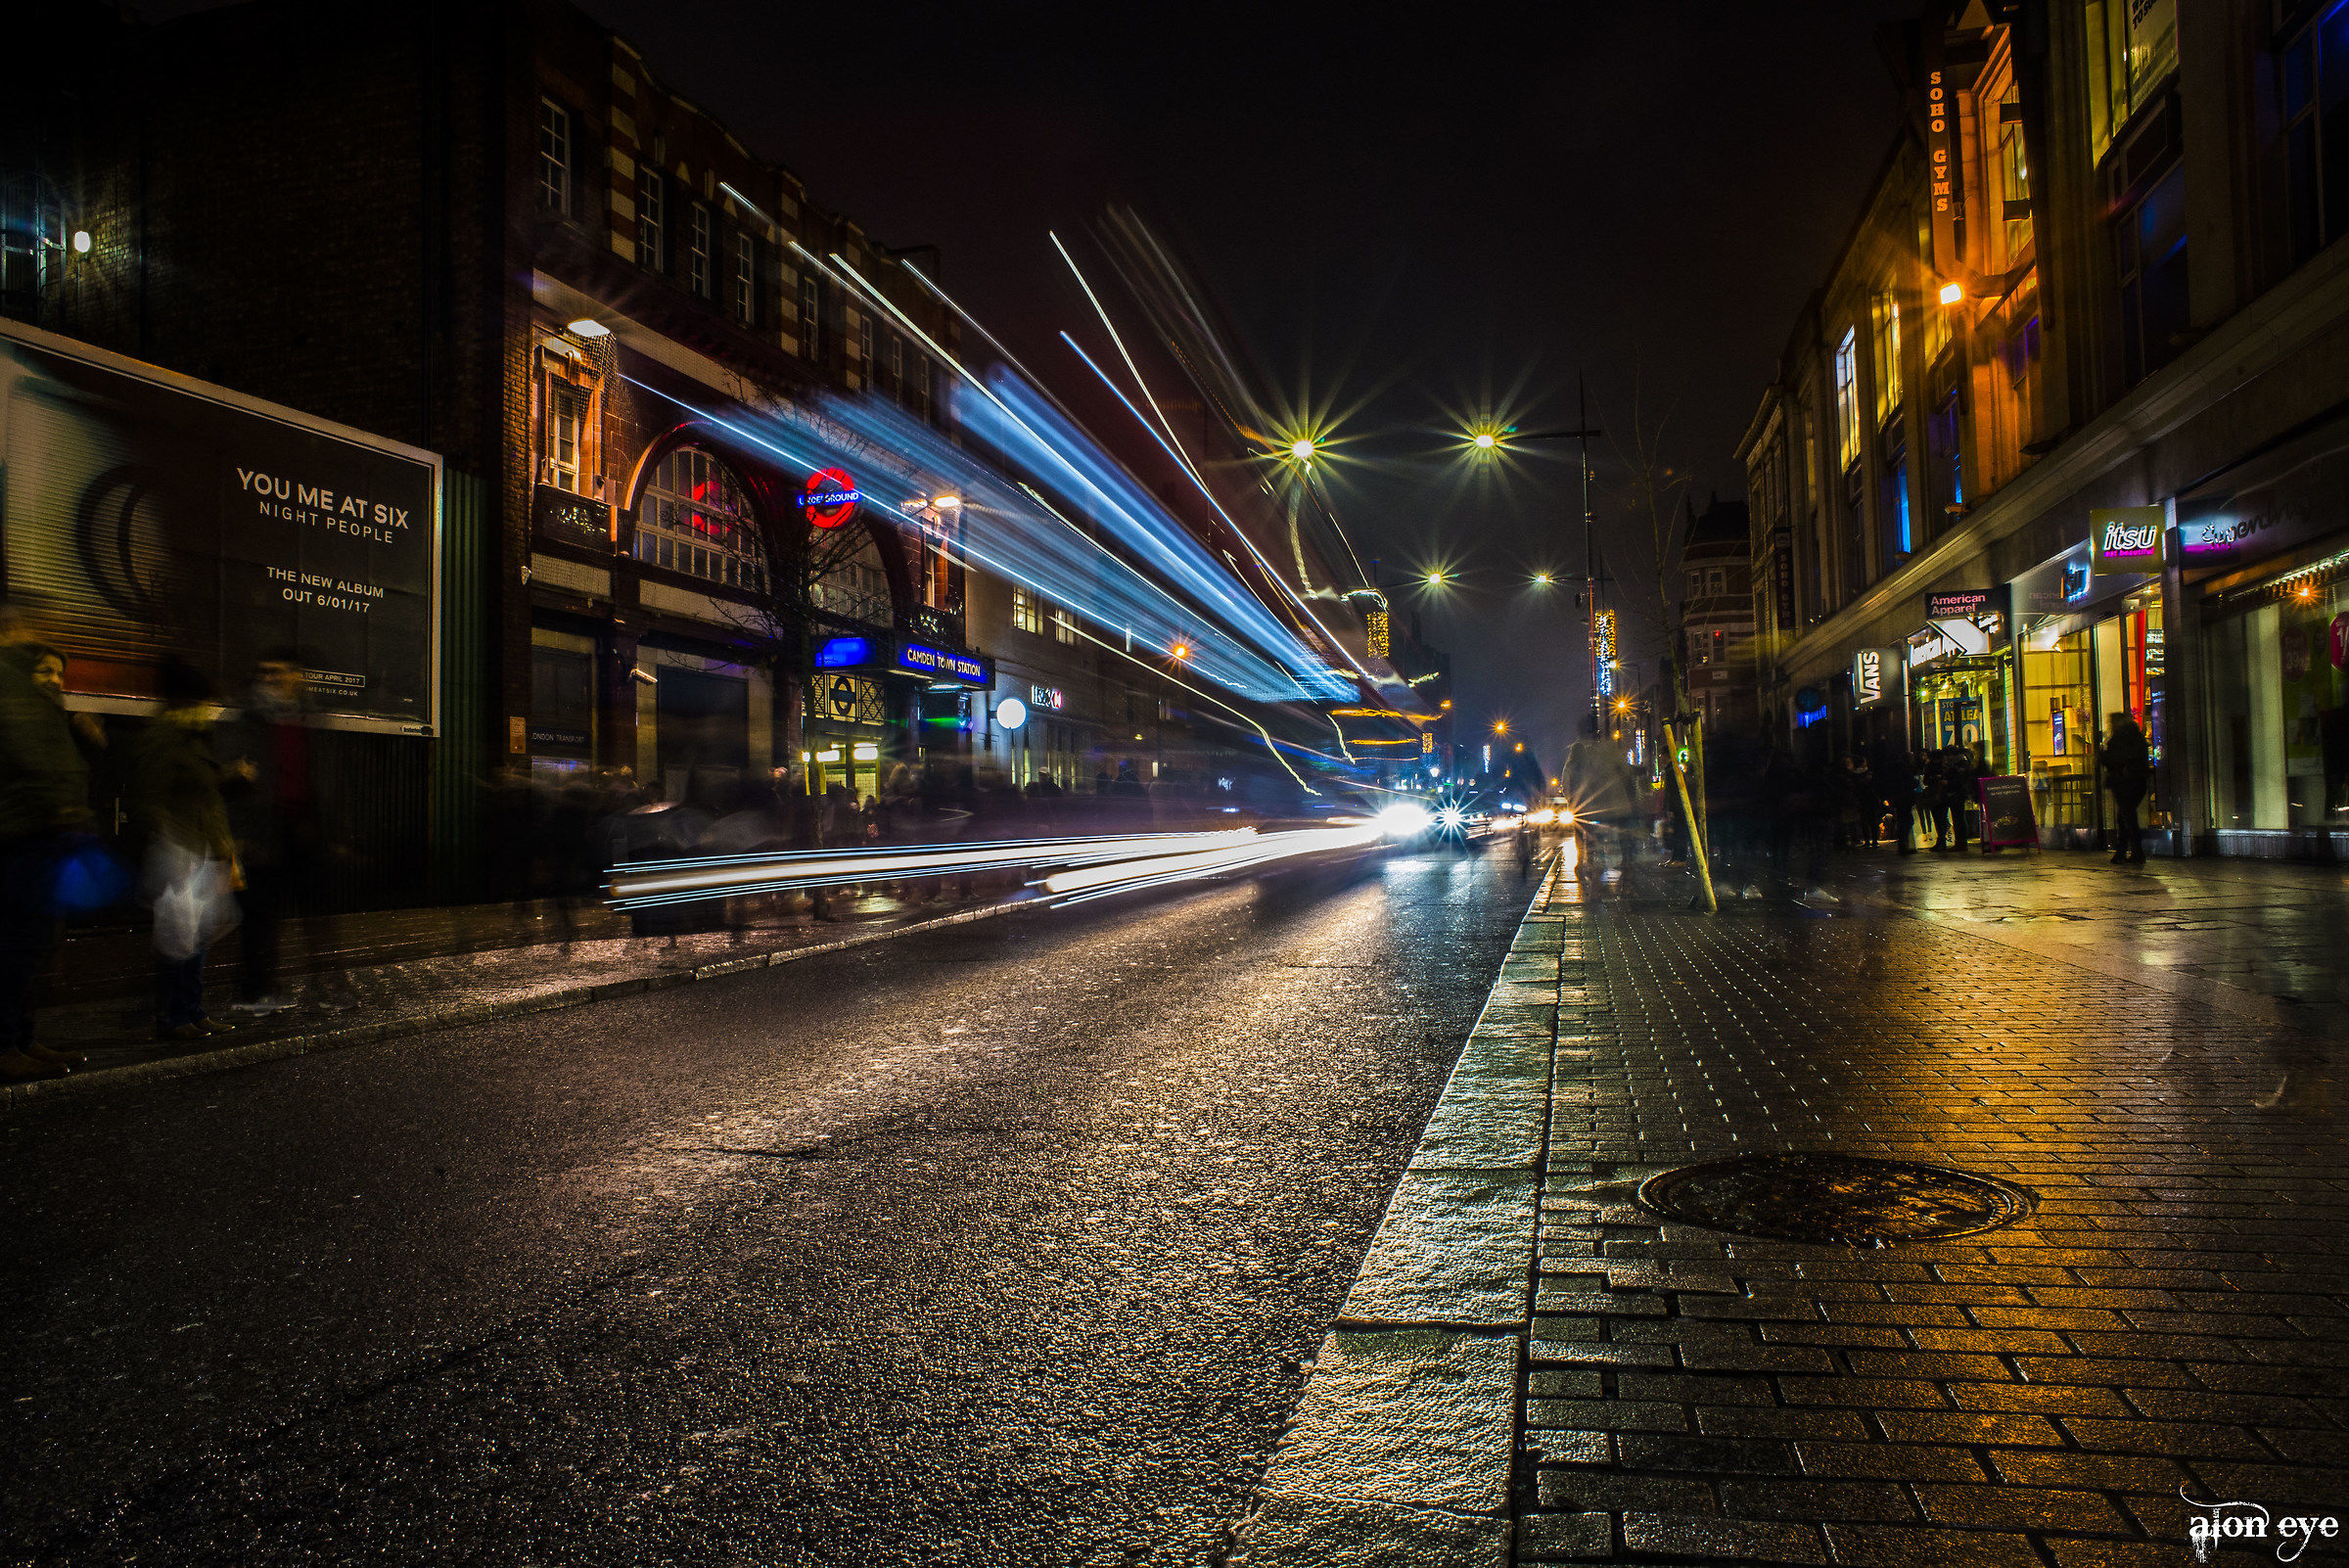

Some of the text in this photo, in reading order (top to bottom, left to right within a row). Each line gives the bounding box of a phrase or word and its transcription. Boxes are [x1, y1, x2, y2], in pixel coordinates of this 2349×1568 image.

[1929, 71, 1950, 212] SOHO GYMS
[237, 467, 409, 530] YOU ME AT SIX
[259, 501, 393, 543] NIGHT PEOPLE
[2103, 521, 2157, 550] itsu
[266, 566, 385, 598] THE NEW ALBUM
[282, 588, 370, 614] OUT 6/01/17
[1930, 594, 1986, 606] American
[1931, 603, 1976, 617] Apparel
[907, 649, 981, 677] CAMDEN TOWN STATION
[1857, 651, 1881, 705] VANS
[532, 732, 554, 741] ONDON
